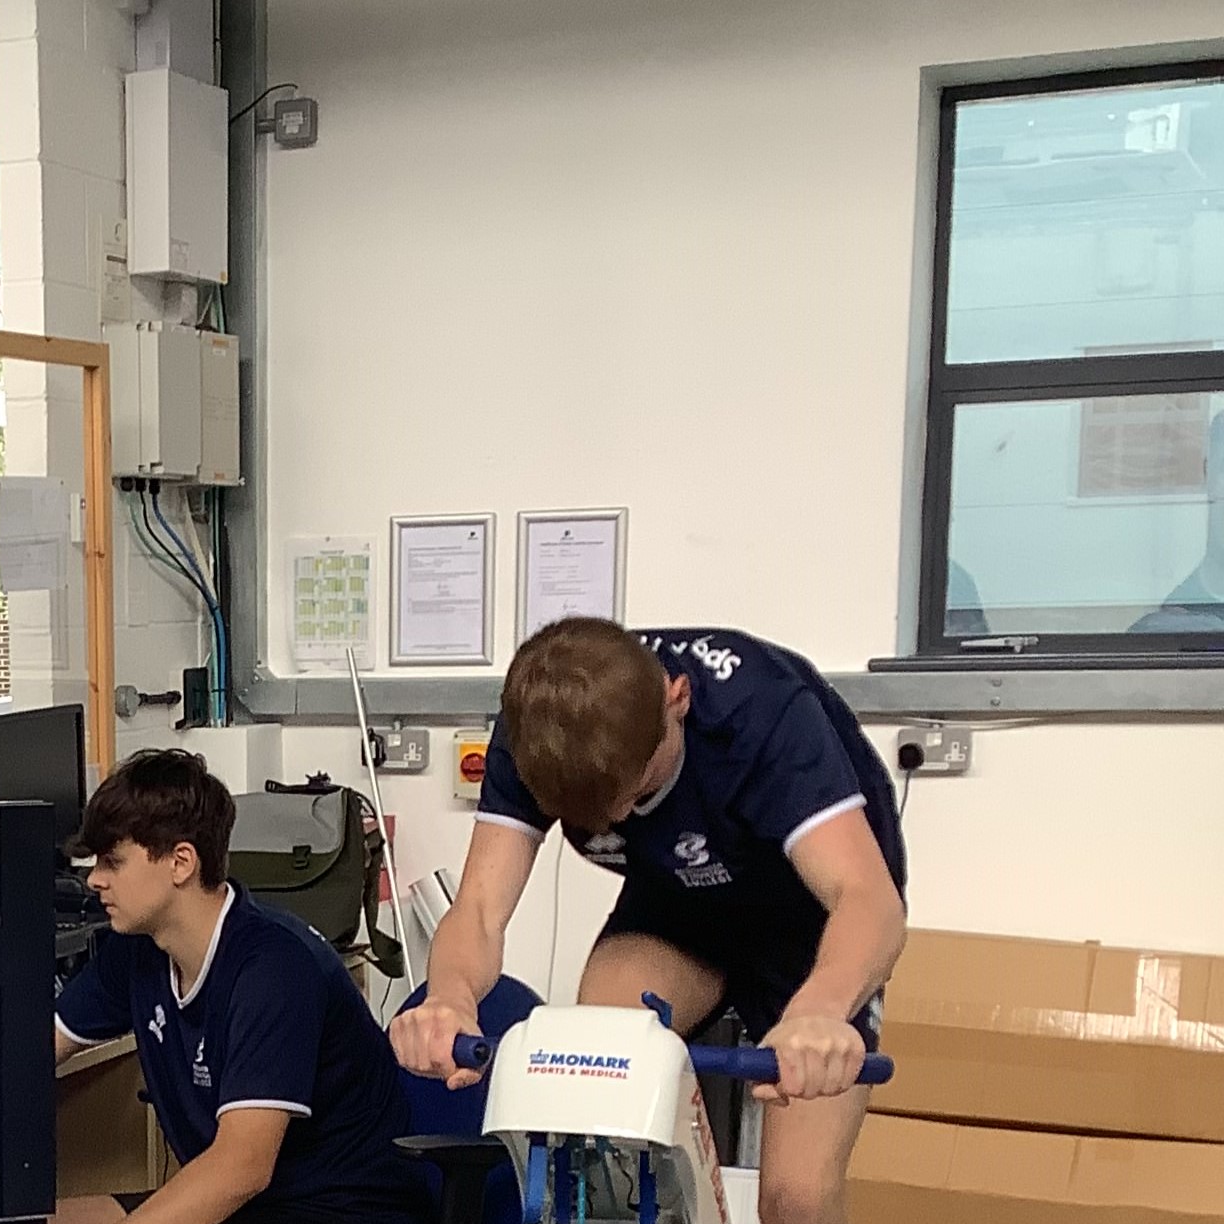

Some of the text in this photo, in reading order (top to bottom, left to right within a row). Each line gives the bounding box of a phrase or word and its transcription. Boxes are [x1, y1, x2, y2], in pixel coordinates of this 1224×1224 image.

[549, 1054, 631, 1070] MONARK
[527, 1066, 565, 1074] SPORTS
[580, 1069, 628, 1079] MEDICAL
